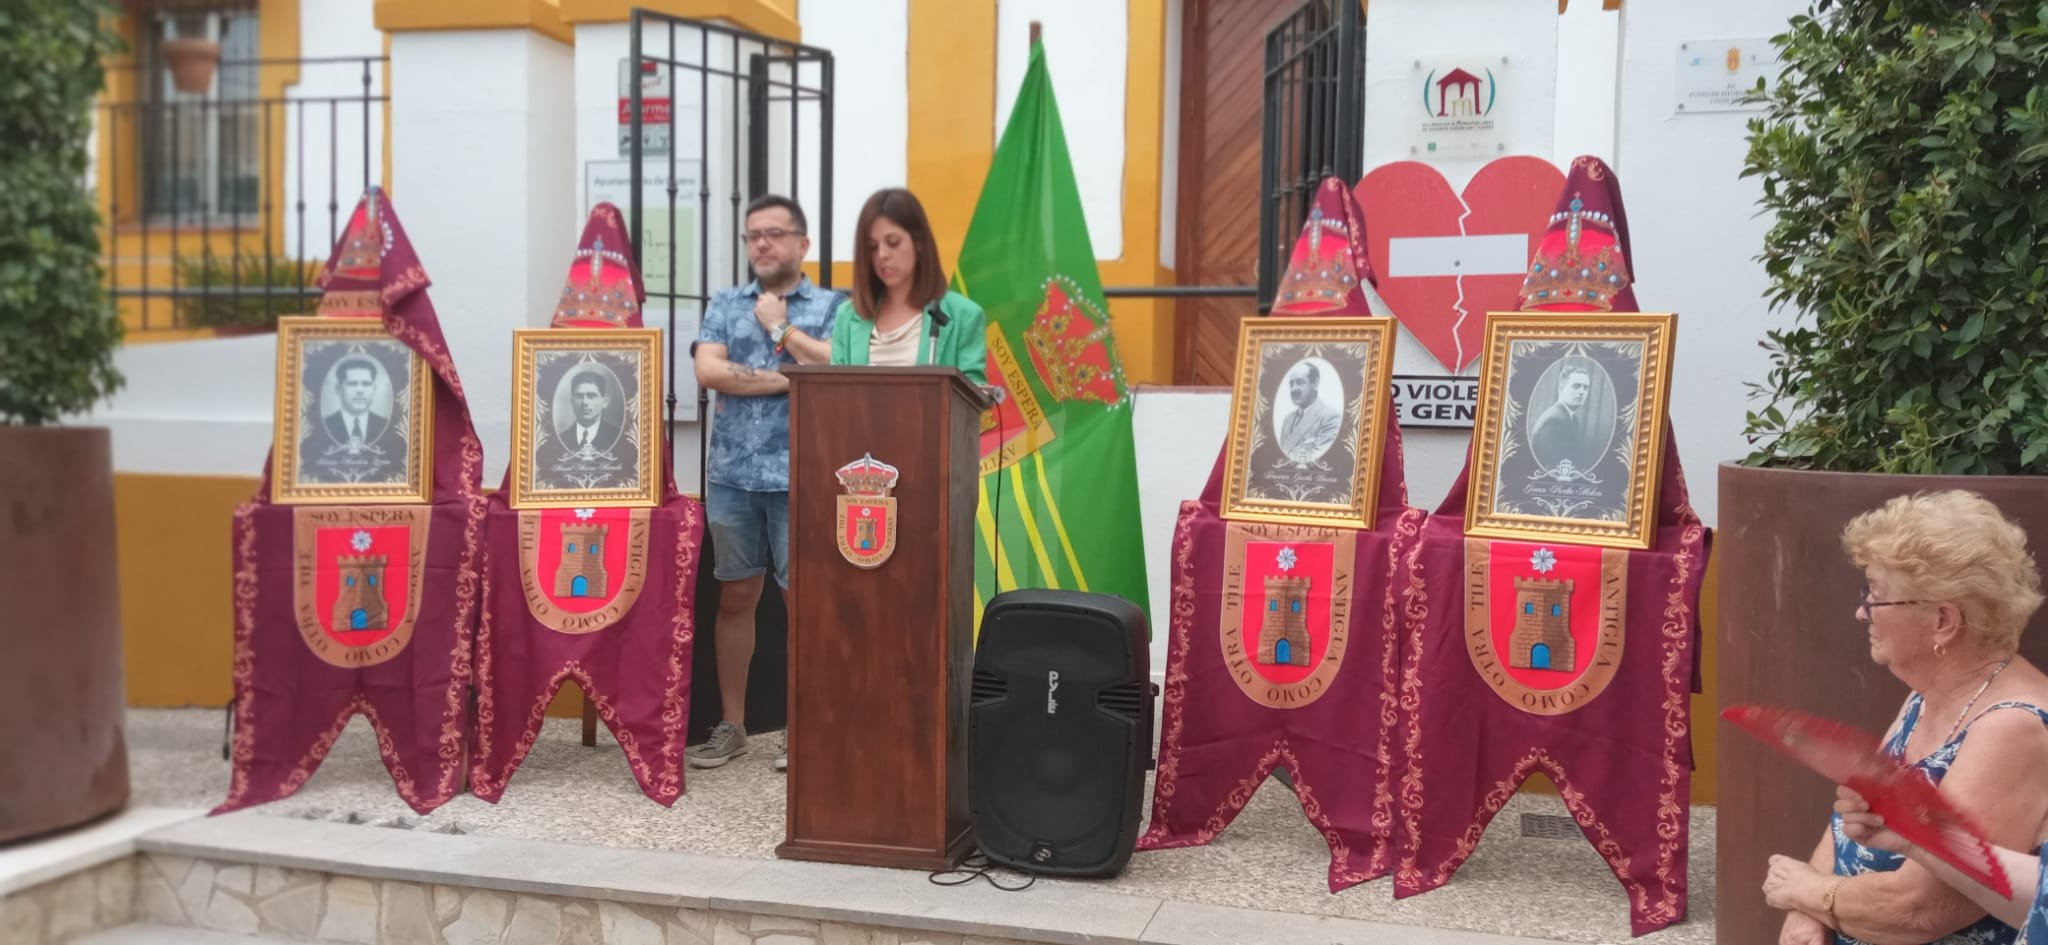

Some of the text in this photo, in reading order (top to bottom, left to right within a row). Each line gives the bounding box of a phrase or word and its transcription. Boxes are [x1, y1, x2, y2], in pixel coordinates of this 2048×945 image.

[991, 337, 1043, 431] SOY ESPERA
[310, 510, 415, 521] SOY ESPERA
[301, 549, 312, 588] TILE
[522, 515, 645, 629] ANTIGUA COMO OTRA TILE
[300, 603, 328, 653] OTRA
[344, 637, 400, 662] COMO
[1226, 565, 1348, 702] ANTIGUA COMO OTRA TILE
[1471, 563, 1619, 708] ANTIGUA COMO OTRA TILE
